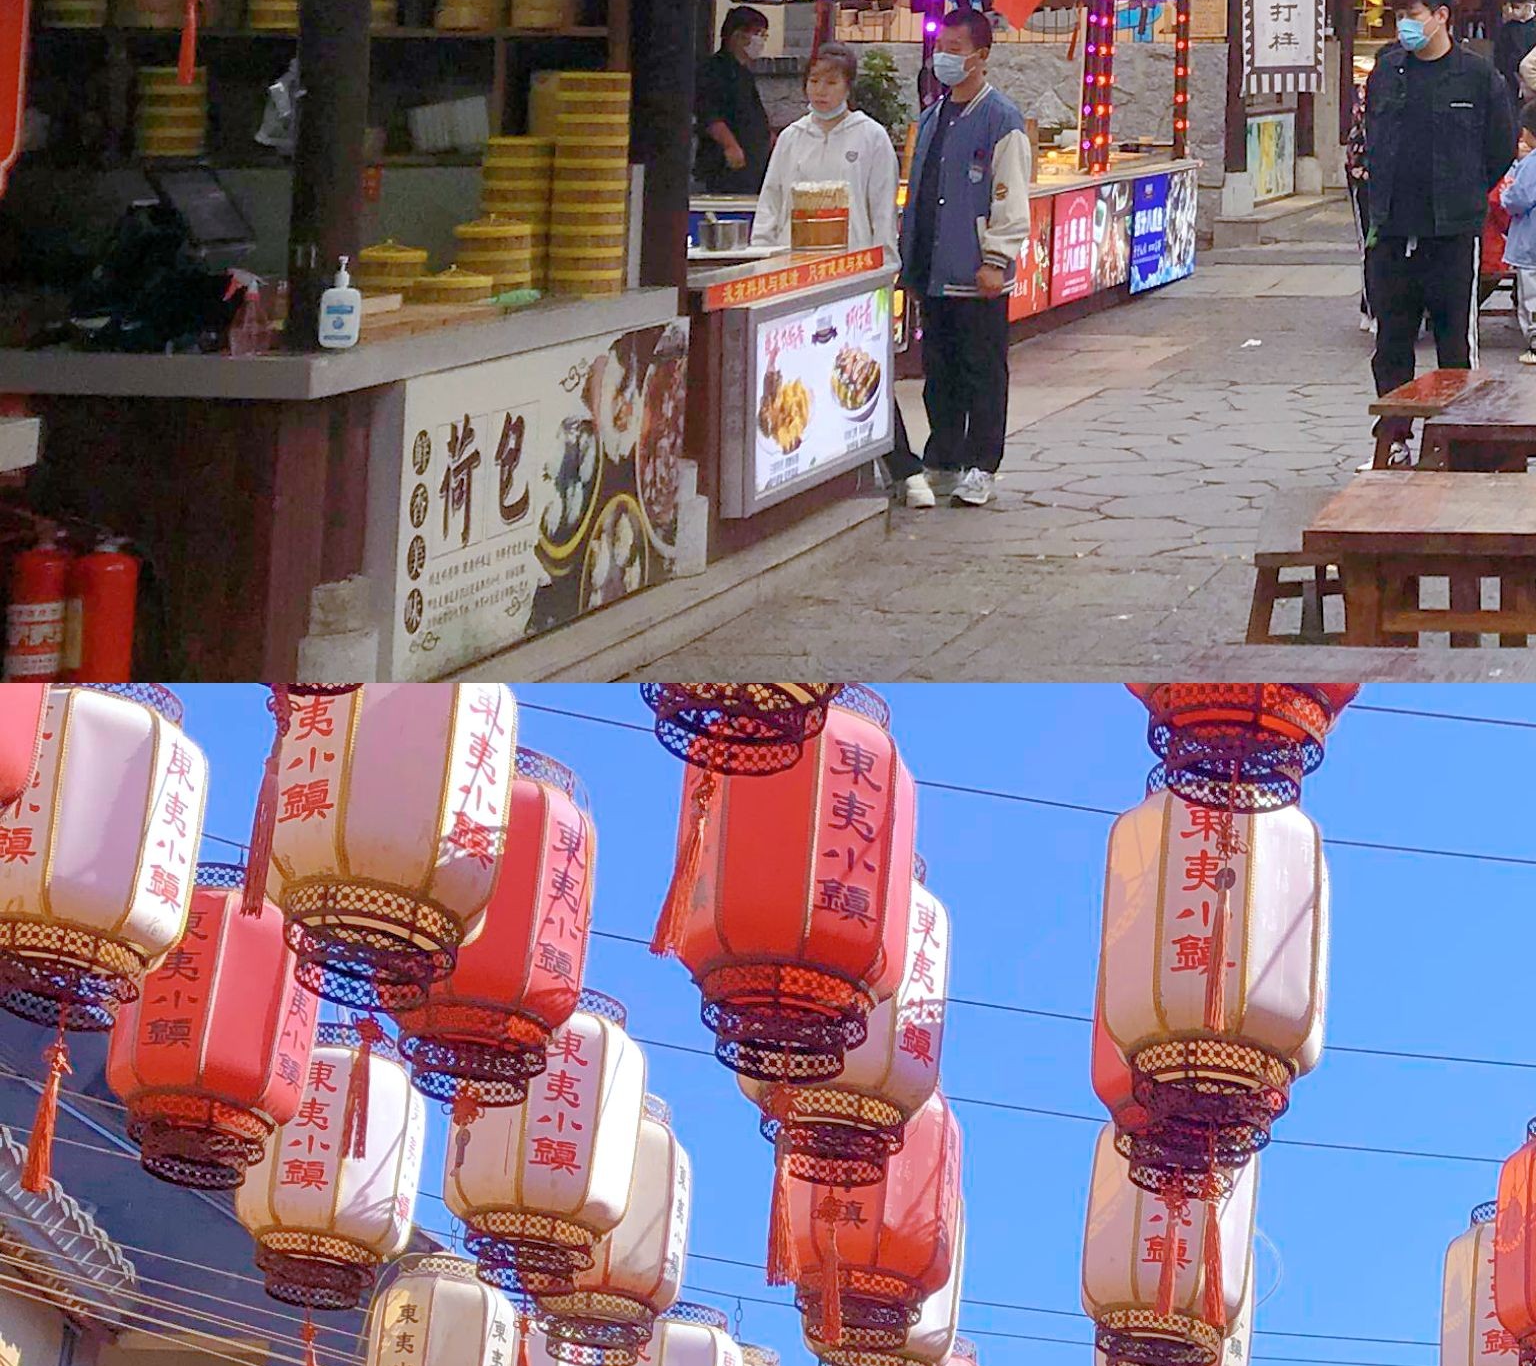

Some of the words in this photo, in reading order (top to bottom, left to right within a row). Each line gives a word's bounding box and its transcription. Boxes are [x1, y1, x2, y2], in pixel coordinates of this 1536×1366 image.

[438, 410, 531, 549] 荷包
[145, 737, 195, 915] 東夷小鎮
[535, 820, 586, 985] 東夷小鎮
[815, 739, 881, 928] 東夷小鎮
[899, 900, 940, 1068] 東夷小鎮
[281, 1060, 337, 1191] 東夷小鎮
[528, 1028, 589, 1176] 東夷小鎮
